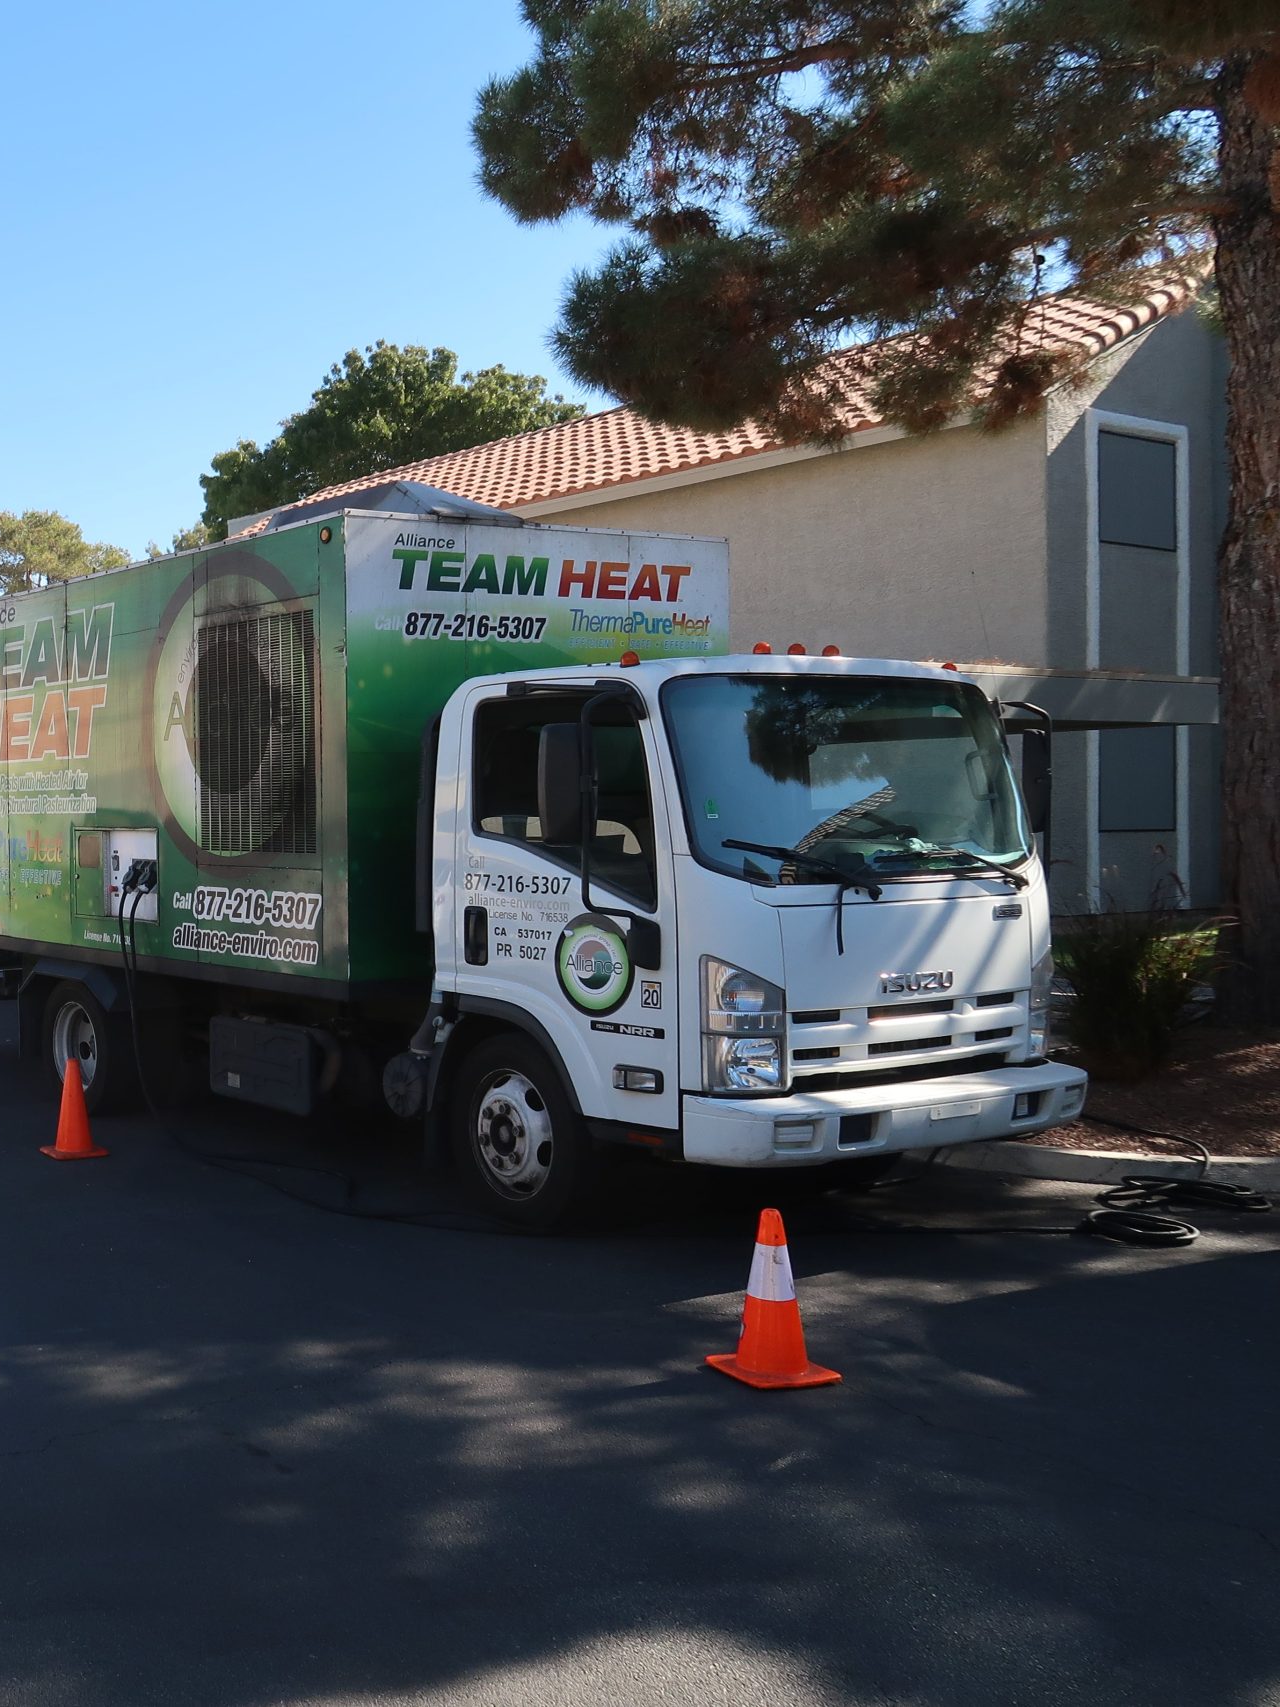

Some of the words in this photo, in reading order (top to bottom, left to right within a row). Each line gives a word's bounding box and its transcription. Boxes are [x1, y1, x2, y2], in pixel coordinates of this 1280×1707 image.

[394, 533, 456, 549] Alliance
[392, 549, 550, 597] TEAM
[557, 559, 692, 603] HEAT
[374, 614, 401, 631] Call
[404, 612, 548, 640] 877-216-5307
[570, 608, 711, 637] ThermaPureHeat
[468, 855, 485, 869] Call
[465, 873, 572, 895] 877-216-5307
[172, 891, 192, 910] Call
[194, 888, 321, 927] 877-216-5307
[468, 893, 570, 911] alliance-enviro.com
[488, 909, 518, 921] License
[540, 911, 569, 923] 716538
[494, 926, 507, 937] CA
[517, 928, 552, 941] 537017
[173, 924, 318, 963] alliance-enviro.com
[496, 943, 512, 957] PR
[519, 945, 547, 961] 5027
[565, 954, 623, 975] Alliance
[880, 969, 953, 994] ISUZU
[643, 988, 659, 1006] 20
[619, 1024, 655, 1037] NRR
